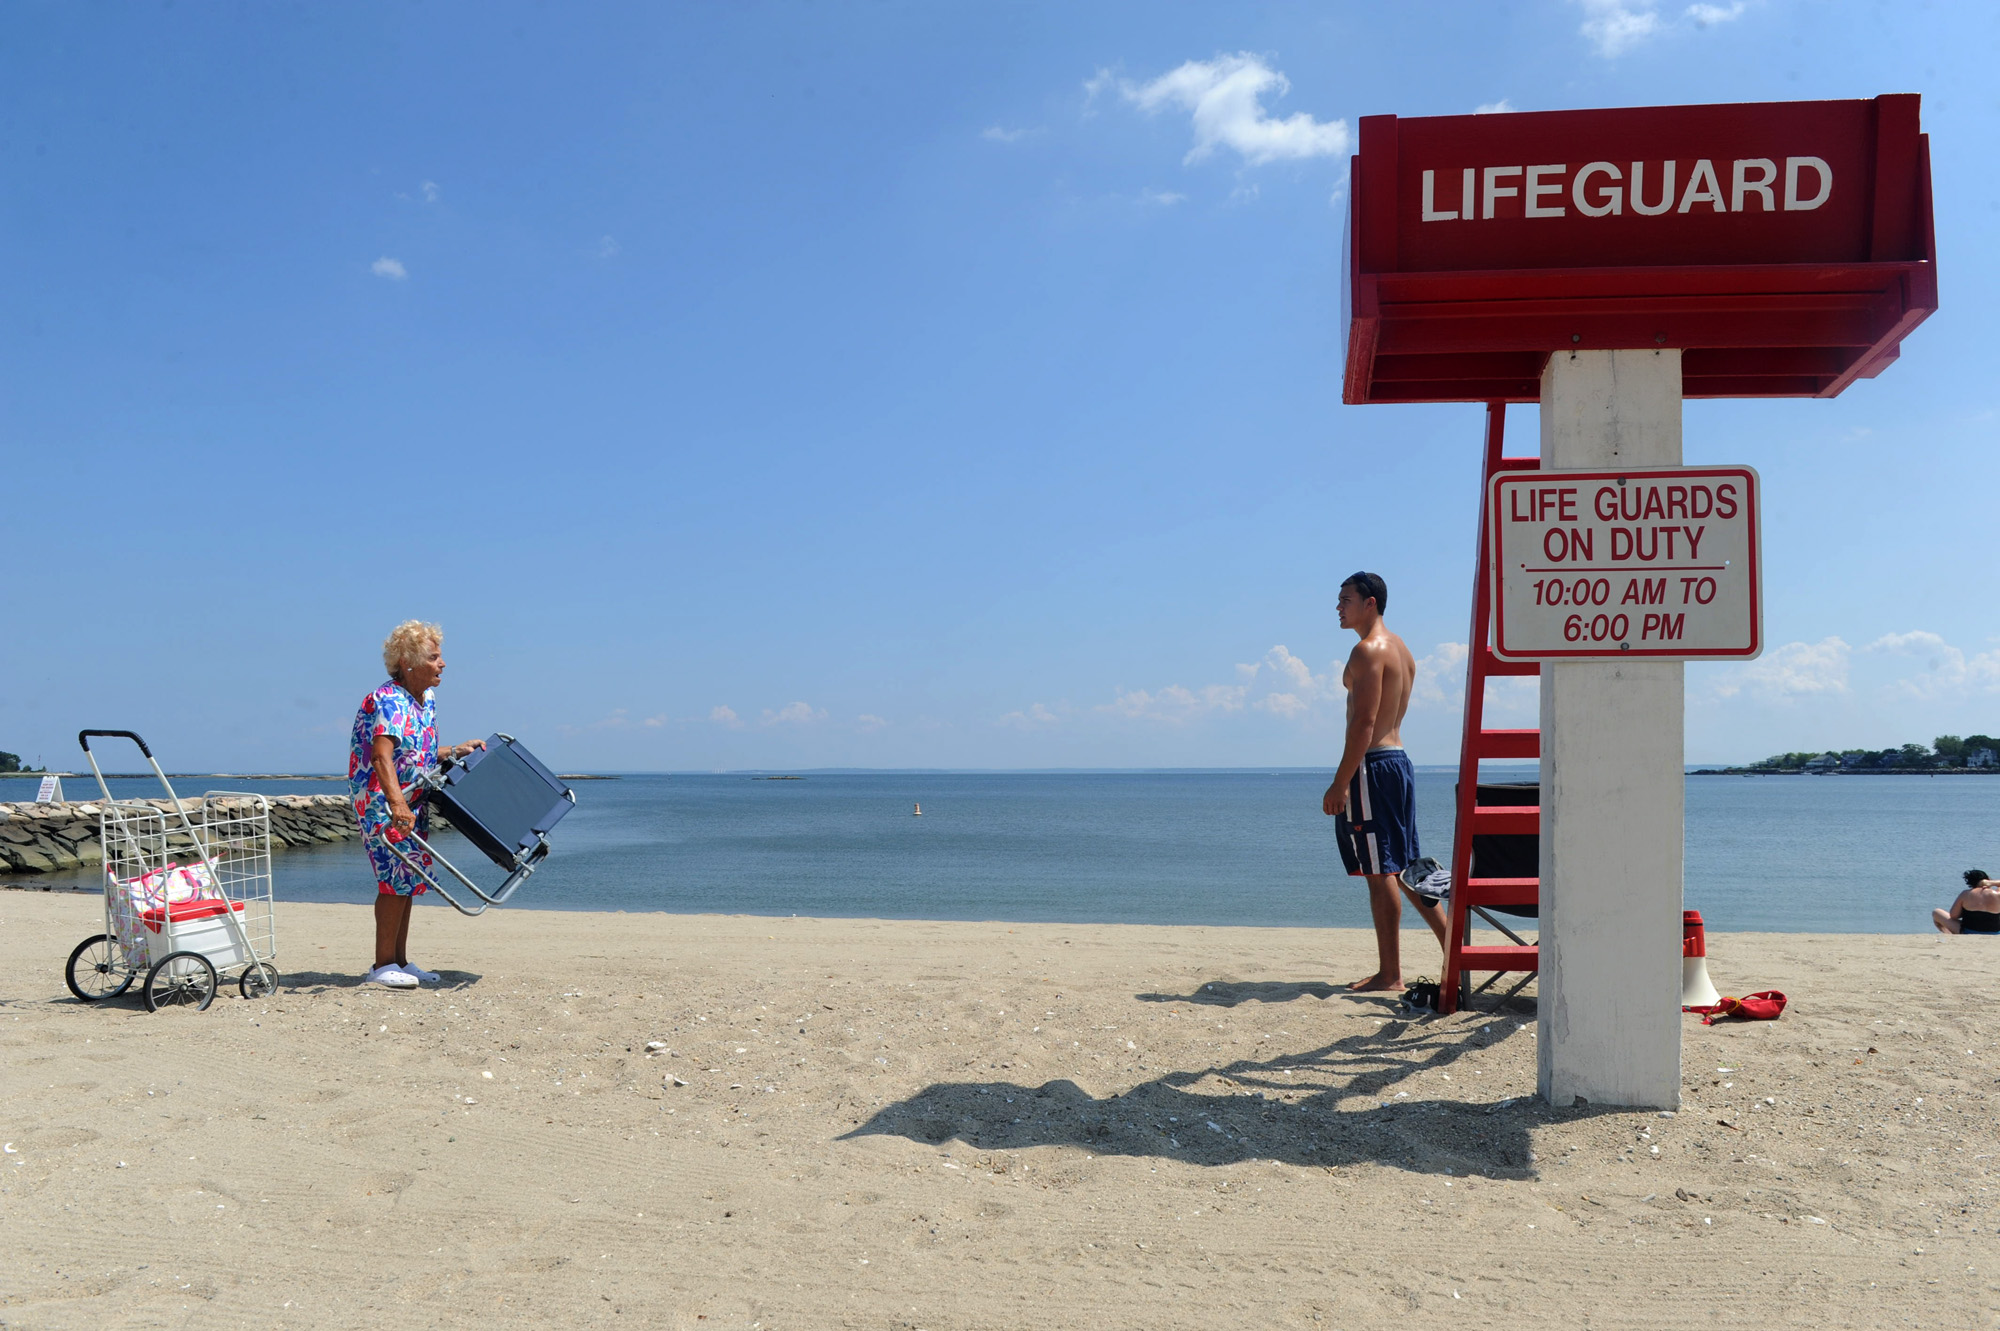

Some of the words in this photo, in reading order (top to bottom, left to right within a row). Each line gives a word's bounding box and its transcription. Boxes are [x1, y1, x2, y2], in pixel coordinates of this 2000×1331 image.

[1421, 157, 1833, 222] LIFEGUARD
[1511, 488, 1578, 522] LIFE
[1594, 484, 1738, 521] GUARDS
[1543, 527, 1593, 562] ON
[1611, 526, 1705, 561] DUTY
[1532, 578, 1610, 606] 10:00
[1620, 578, 1666, 605] AM
[1680, 576, 1717, 605] TO
[1563, 613, 1629, 642] 6:00
[1641, 613, 1685, 641] PM
